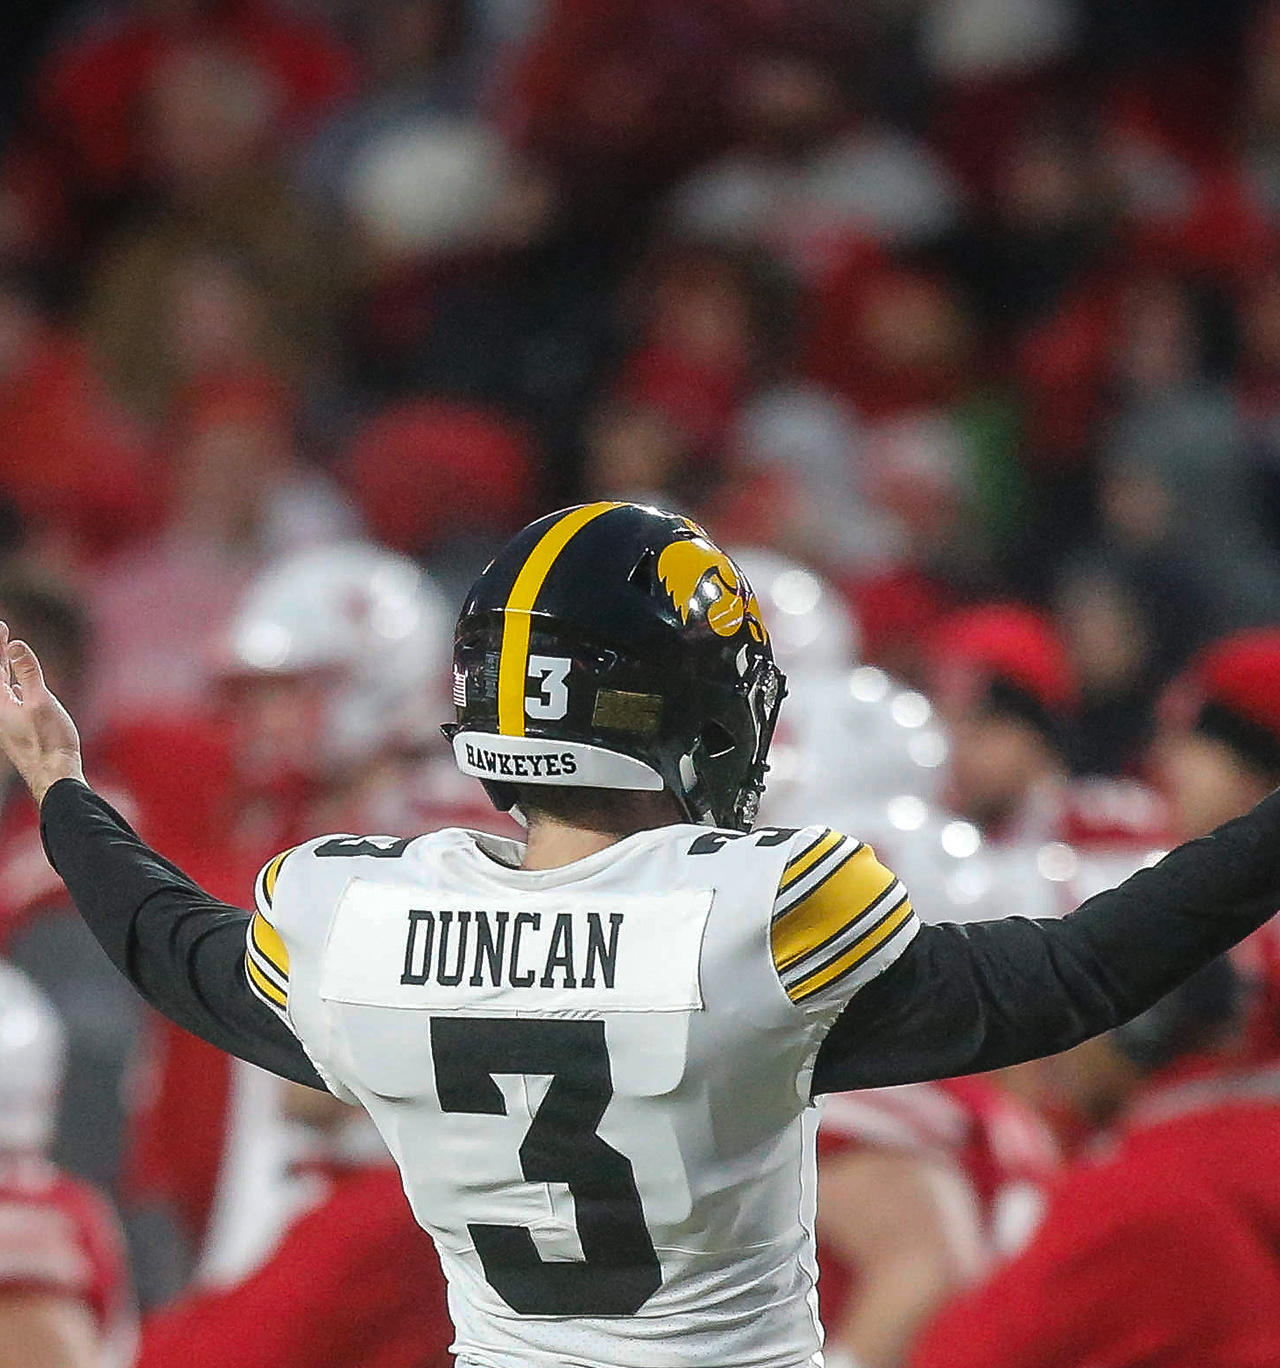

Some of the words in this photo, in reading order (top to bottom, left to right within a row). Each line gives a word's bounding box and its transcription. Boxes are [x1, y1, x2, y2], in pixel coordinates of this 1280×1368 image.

[524, 654, 572, 721] 3
[465, 743, 578, 776] HAWKEYES
[400, 909, 624, 989] DUNCAN
[429, 1016, 663, 1317] 3
